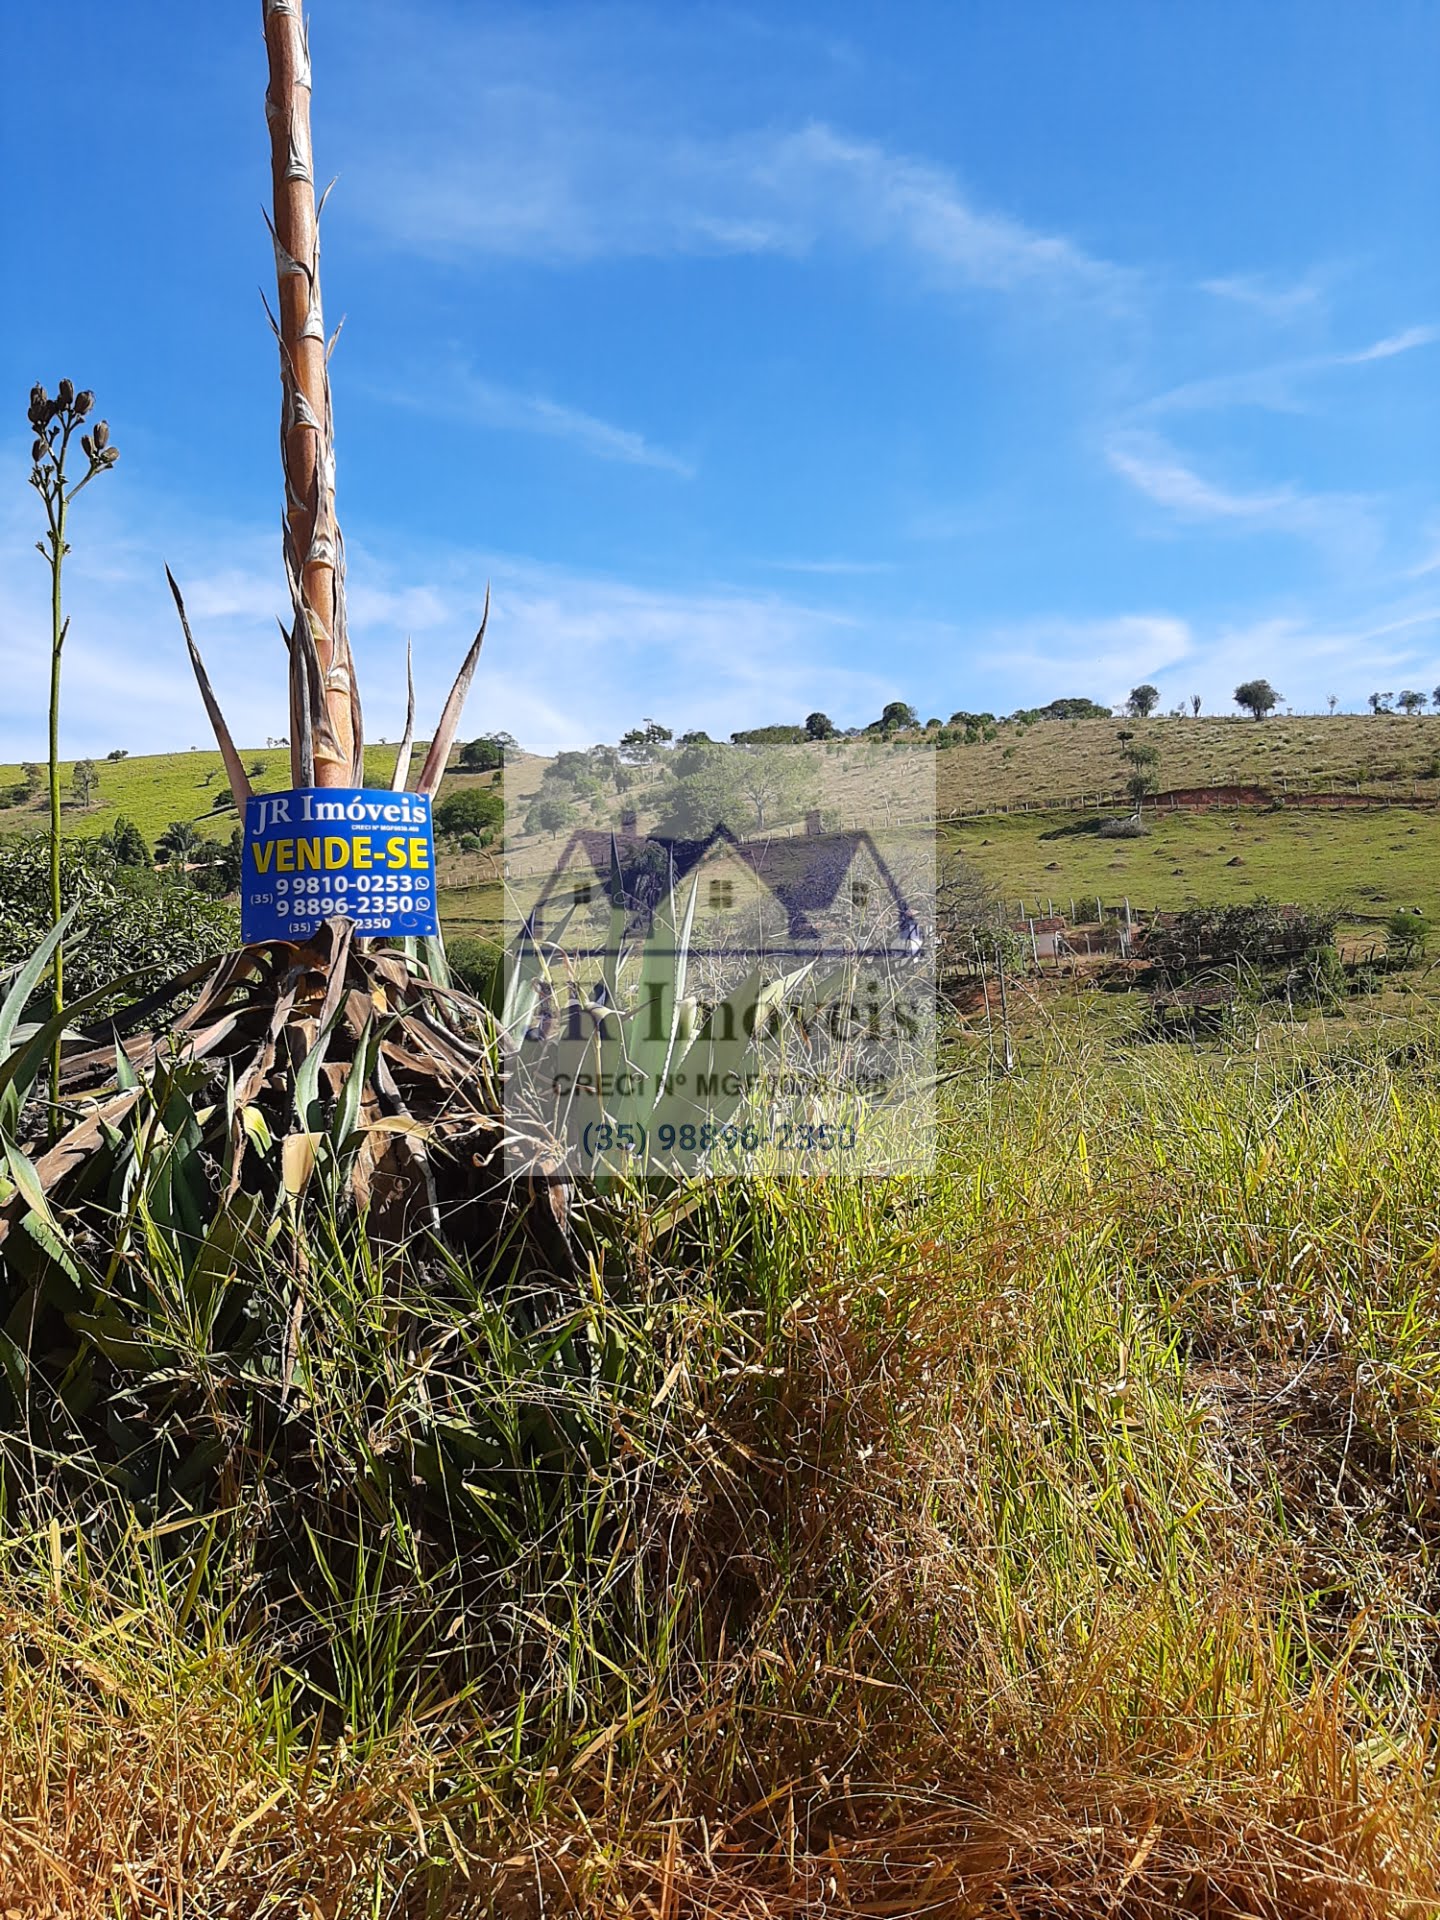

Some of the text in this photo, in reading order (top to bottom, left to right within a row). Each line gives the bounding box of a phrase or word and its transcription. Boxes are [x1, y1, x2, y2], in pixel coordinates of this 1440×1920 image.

[252, 795, 427, 835] JR Imóveis
[252, 836, 429, 874] VENDE-SE
[276, 875, 412, 896] 9 9810-0253
[250, 893, 273, 905] (35)
[276, 896, 413, 917] 9 8896-2350
[289, 922, 311, 933] (35)
